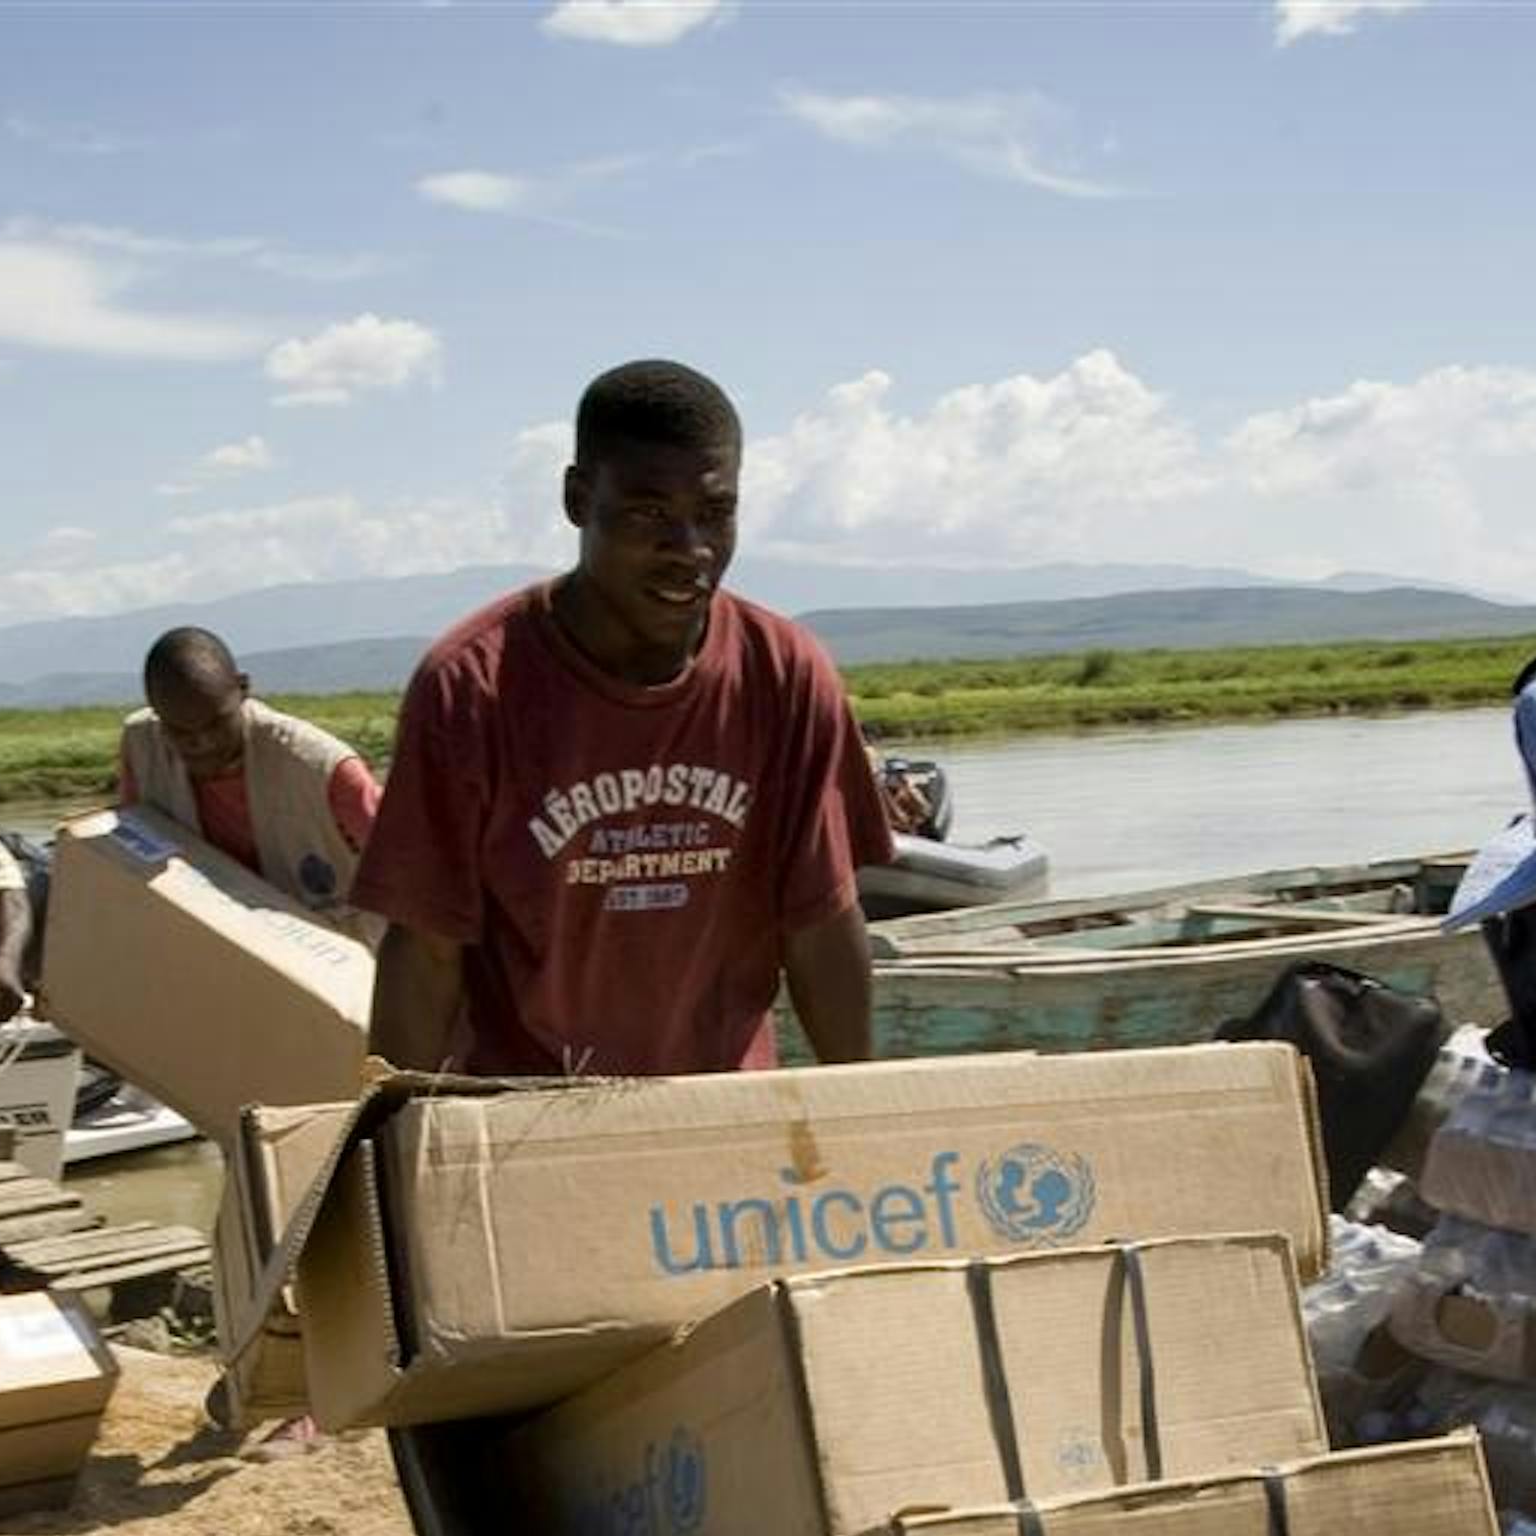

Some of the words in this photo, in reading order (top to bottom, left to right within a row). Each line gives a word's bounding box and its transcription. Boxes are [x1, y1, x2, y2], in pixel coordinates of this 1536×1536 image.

[528, 763, 754, 860] AÉROPOSTAL
[590, 821, 710, 853] ATHLETIC
[566, 847, 733, 884] DEPARTMENT
[650, 1151, 961, 1277] unicef
